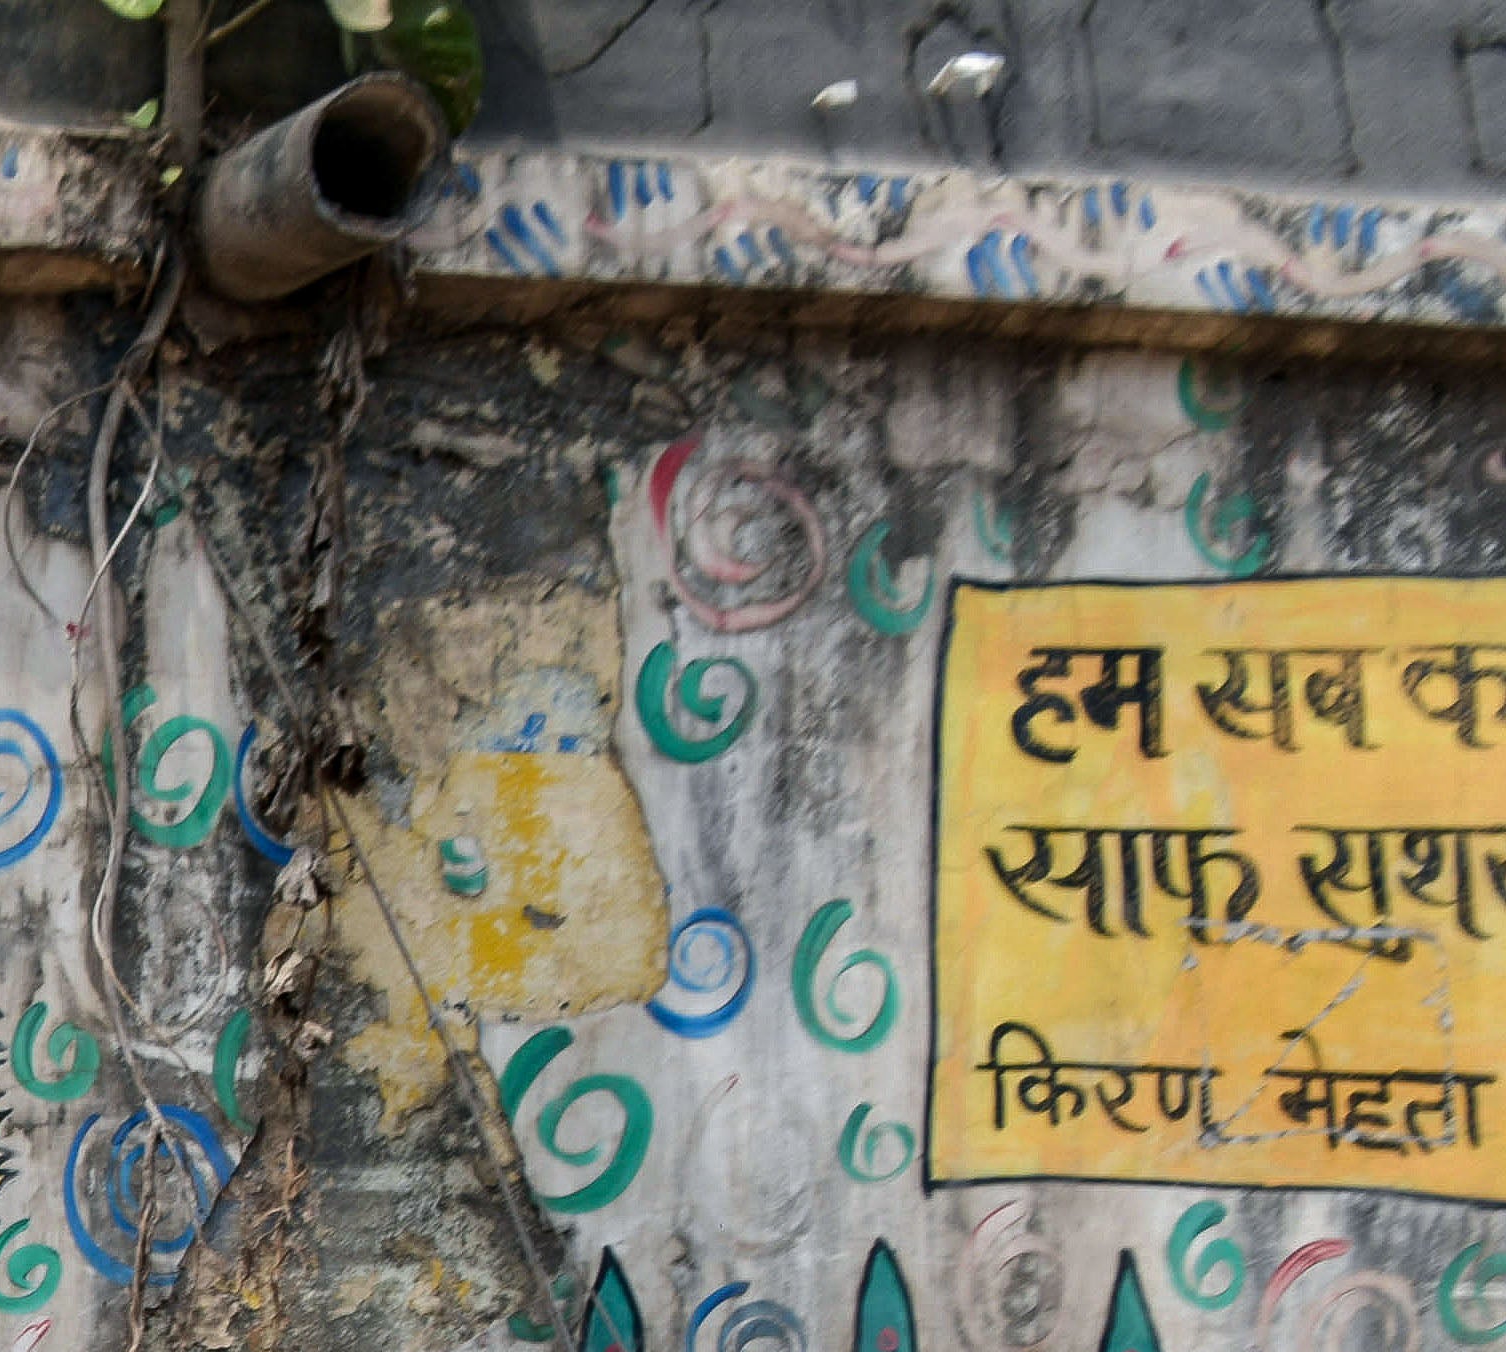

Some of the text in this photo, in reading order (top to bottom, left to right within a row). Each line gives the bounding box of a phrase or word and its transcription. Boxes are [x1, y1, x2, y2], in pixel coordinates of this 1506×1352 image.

[1010, 645, 1169, 763] हम
[1196, 645, 1386, 755] सब
[976, 1022, 1498, 1156] किरण मेहता
